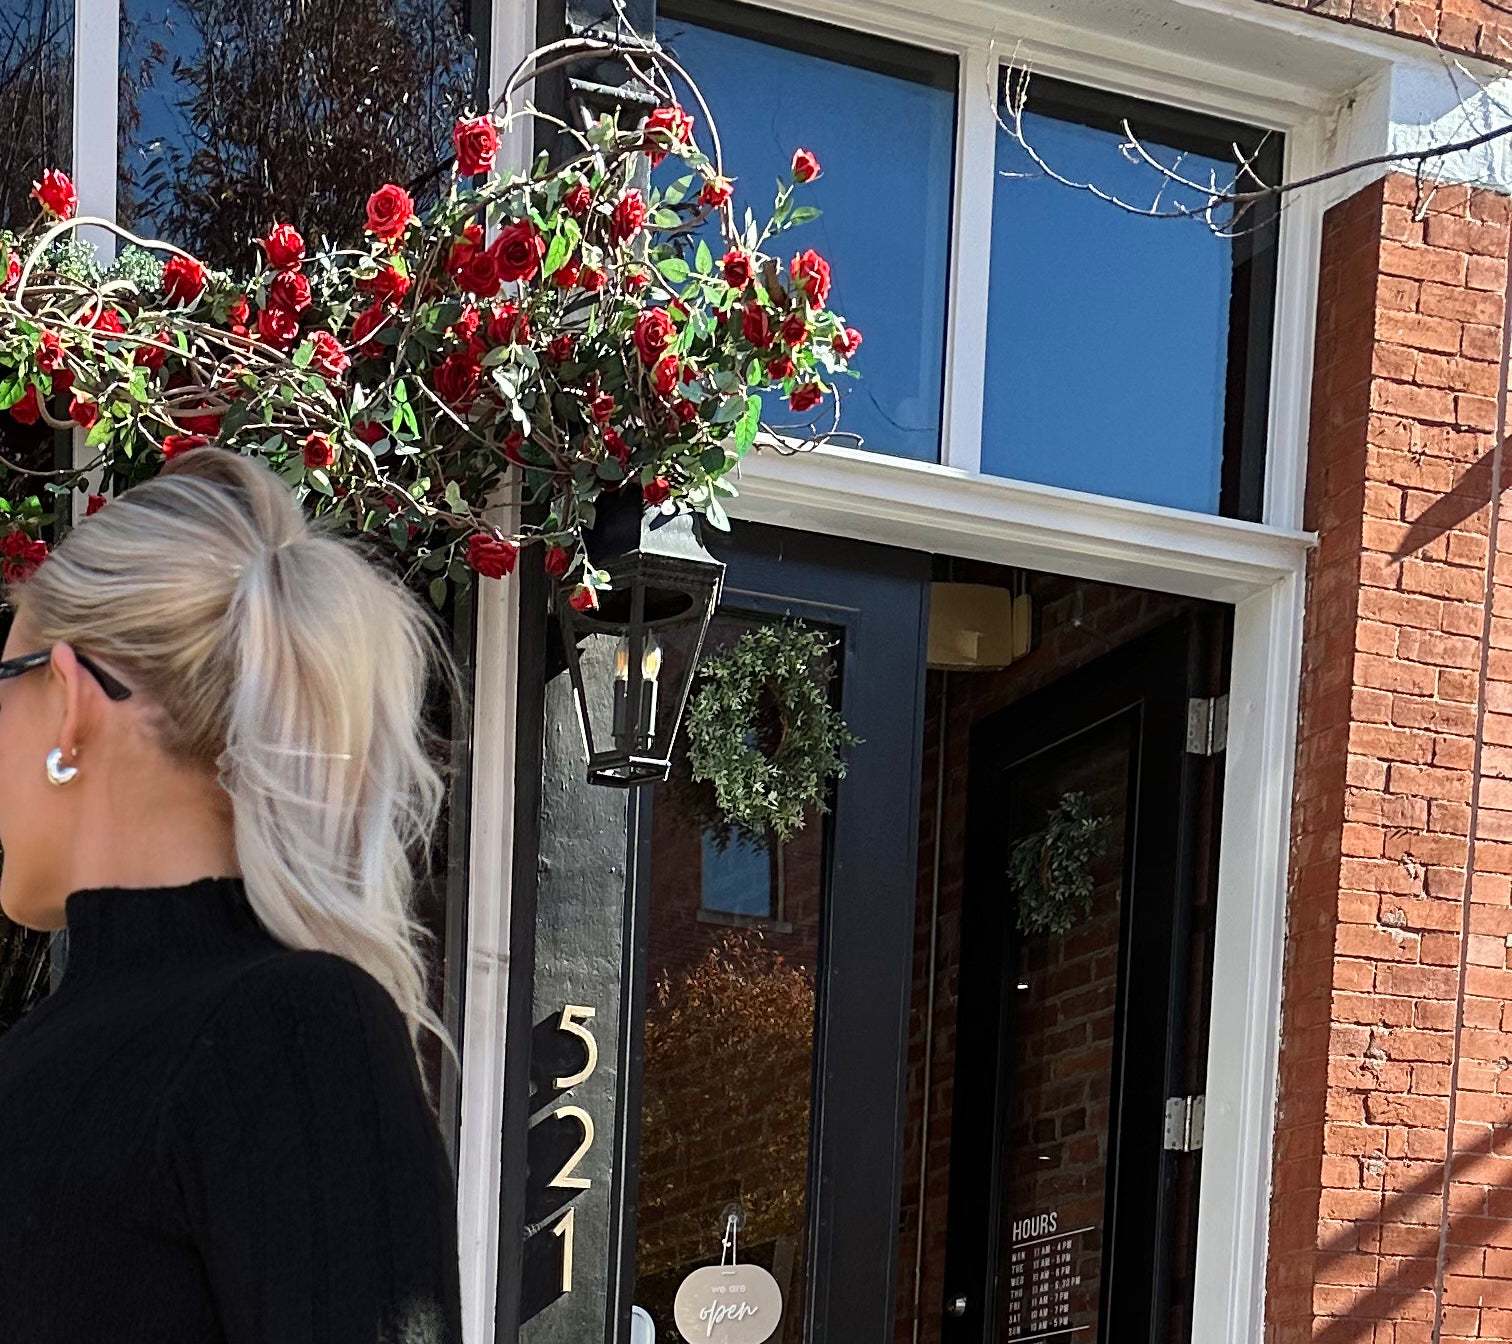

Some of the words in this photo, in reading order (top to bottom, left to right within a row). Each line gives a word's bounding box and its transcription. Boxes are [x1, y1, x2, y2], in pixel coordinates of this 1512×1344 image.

[546, 1004, 598, 1292] 521
[1012, 1211, 1058, 1242] HOURS
[1011, 1251, 1026, 1262] MON
[1041, 1245, 1051, 1255] AM
[1062, 1240, 1072, 1249] PM
[1011, 1264, 1024, 1274] TUE
[1040, 1258, 1050, 1267] AM
[1061, 1253, 1071, 1262] PM
[1011, 1276, 1024, 1287] WED
[1040, 1270, 1049, 1280] AM
[1061, 1266, 1070, 1274] PM
[711, 1285, 726, 1293] we
[729, 1284, 746, 1292] are
[1010, 1288, 1023, 1299] THU
[1039, 1283, 1049, 1292] AM
[1071, 1276, 1081, 1285] PM
[1009, 1302, 1020, 1312] FRI
[1039, 1295, 1048, 1305] AM
[1059, 1291, 1069, 1300] PM
[699, 1300, 759, 1337] open
[1009, 1314, 1021, 1324] SAT
[1039, 1308, 1048, 1317] AM
[1059, 1304, 1069, 1313] PM
[1008, 1326, 1021, 1336] SUN
[1038, 1320, 1048, 1329] AM
[1059, 1316, 1068, 1325] PM
